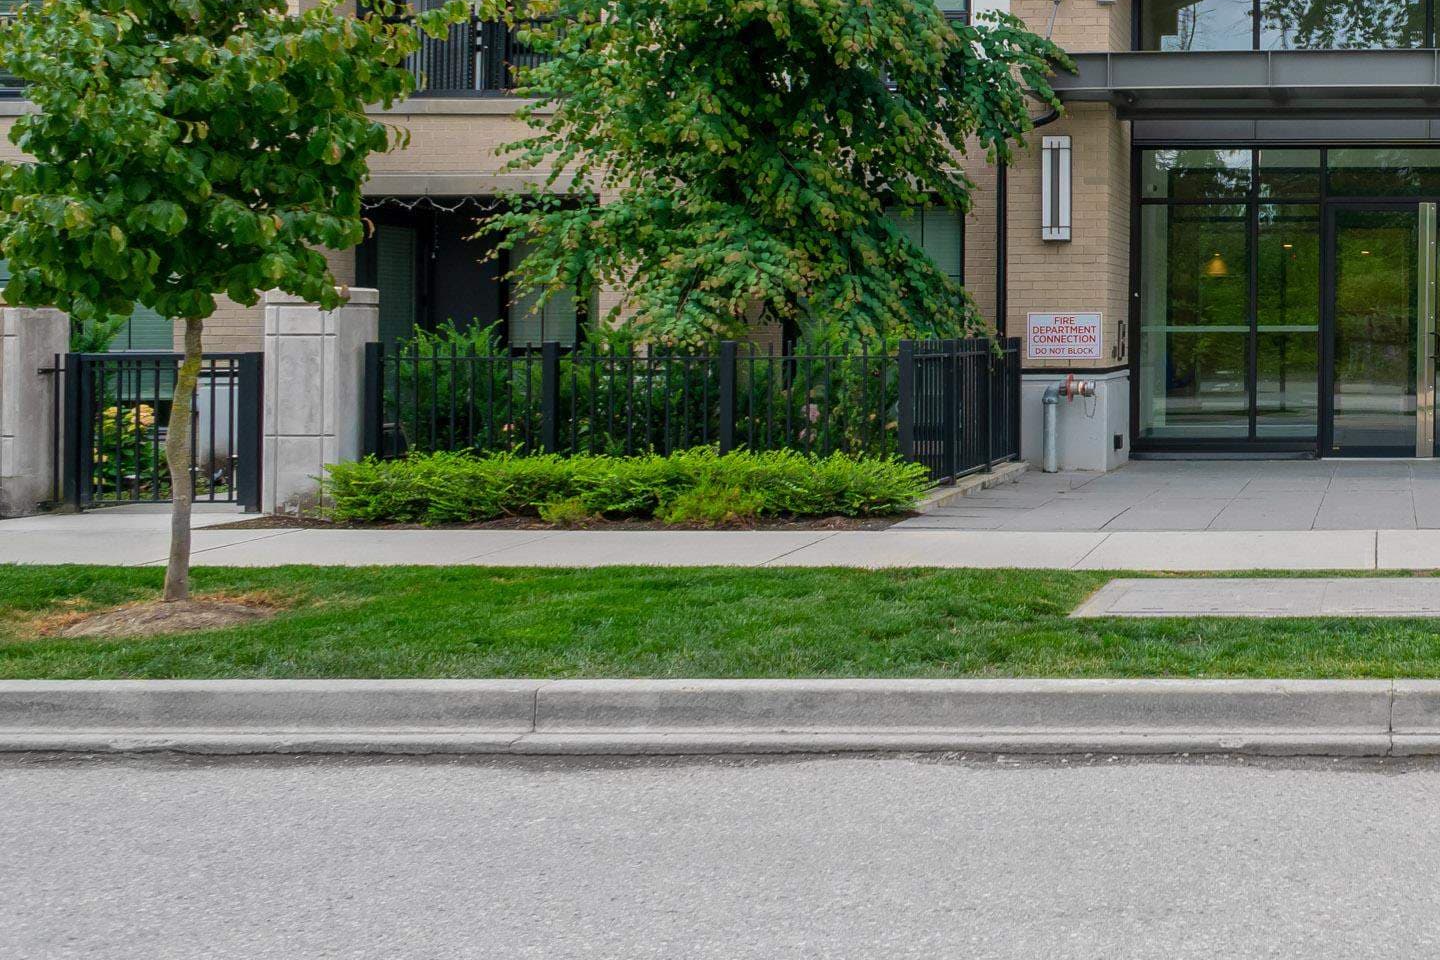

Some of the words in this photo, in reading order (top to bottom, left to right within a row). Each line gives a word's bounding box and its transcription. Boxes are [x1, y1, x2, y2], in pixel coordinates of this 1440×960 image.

[1054, 316, 1075, 324] FIRE
[1032, 325, 1096, 334] DEPARTMENT
[1032, 335, 1096, 343] CONNECTION
[1035, 347, 1047, 355] DO
[1049, 347, 1066, 355] NOT
[1067, 347, 1094, 355] BLOCK
